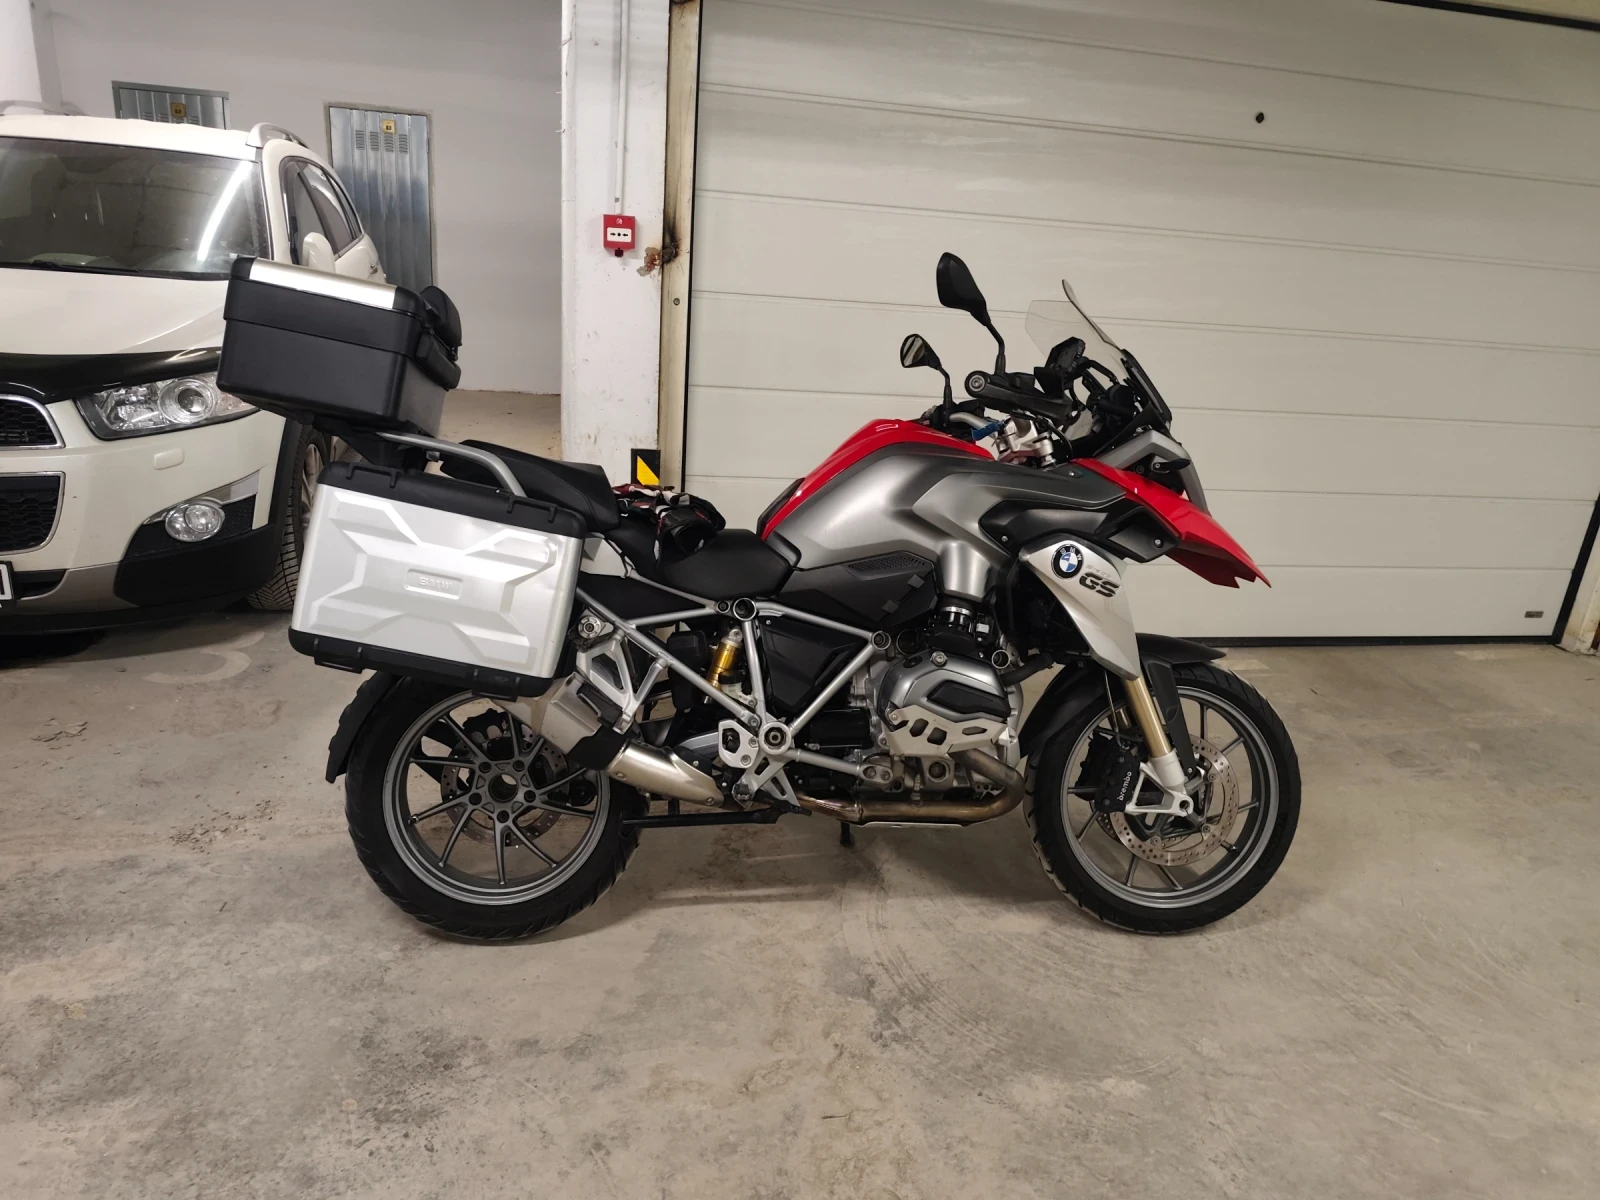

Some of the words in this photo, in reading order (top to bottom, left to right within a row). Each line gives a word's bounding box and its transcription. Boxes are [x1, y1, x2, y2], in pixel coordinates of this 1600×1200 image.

[1060, 546, 1083, 561] BMW
[1079, 572, 1121, 598] GS
[1116, 771, 1132, 801] brembo
